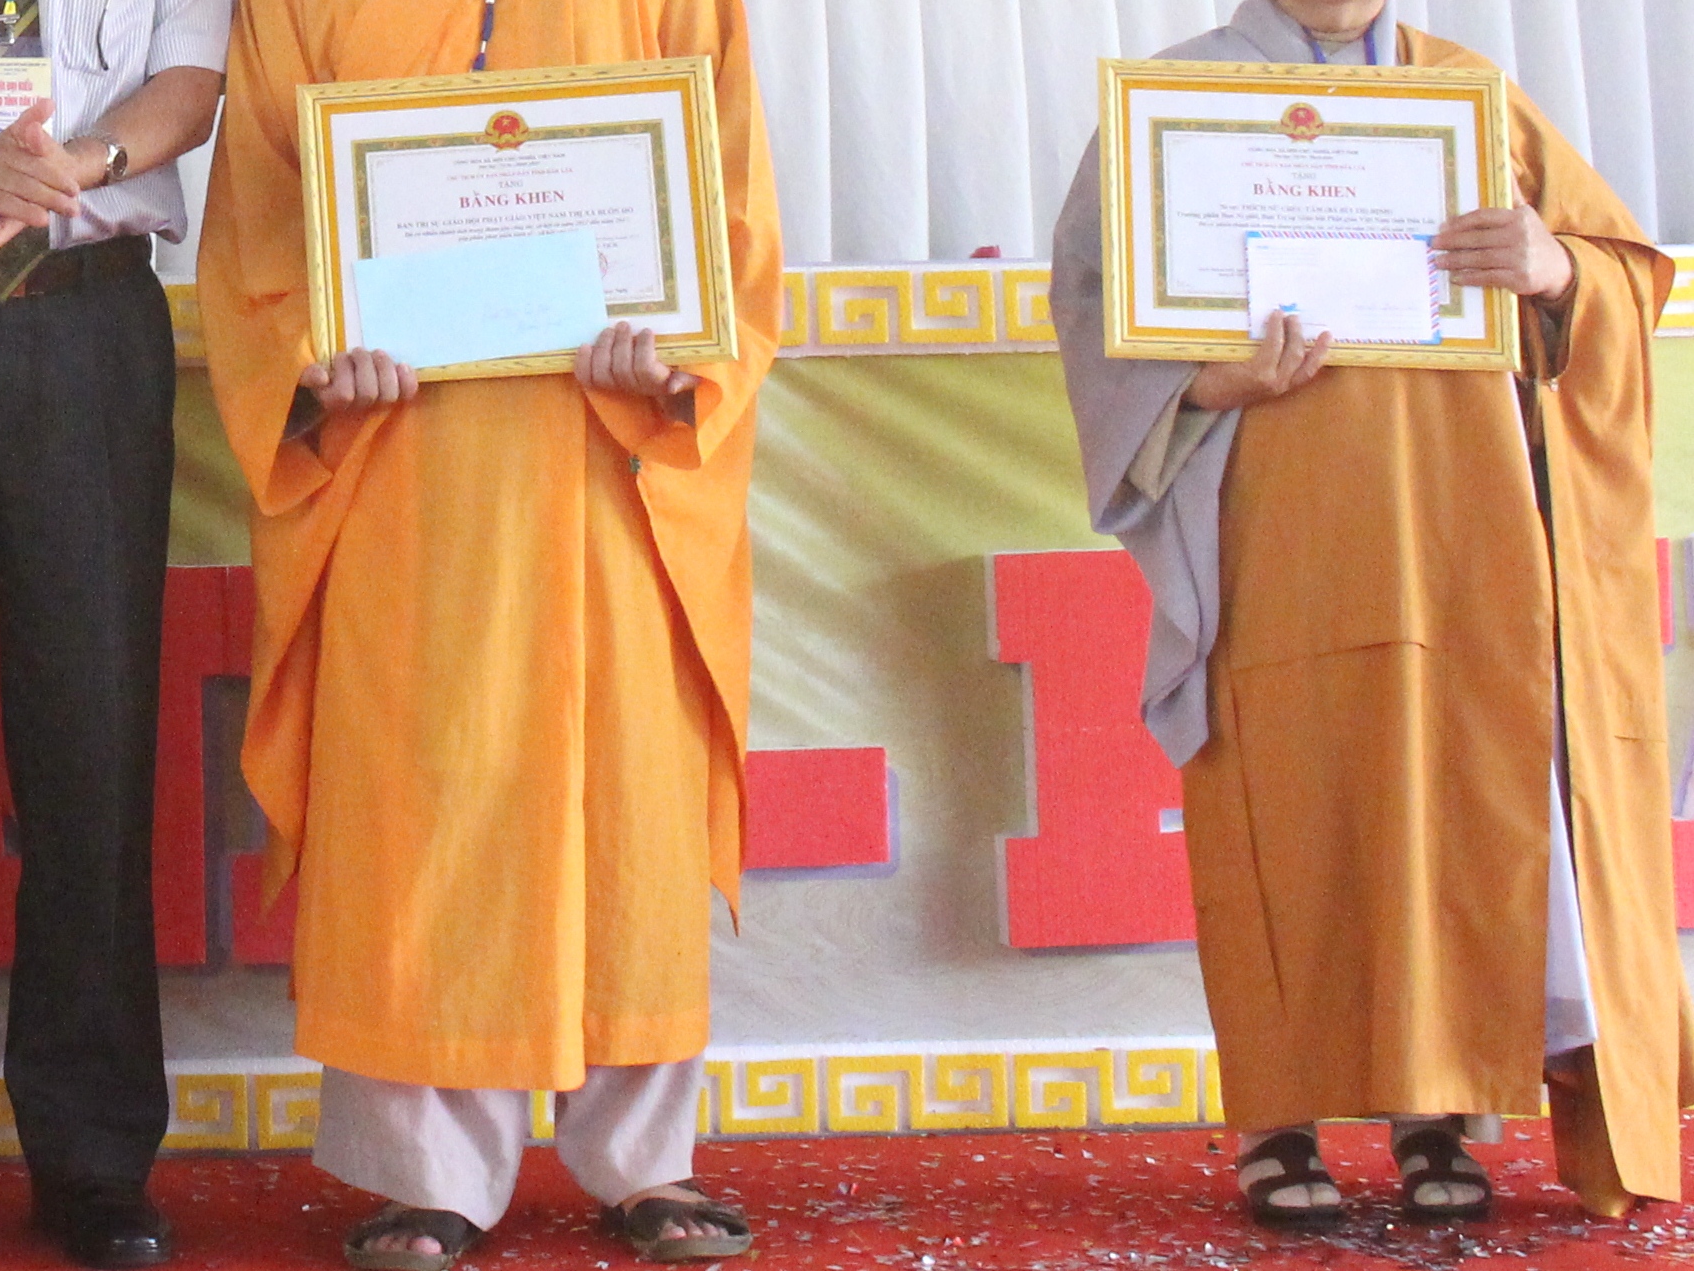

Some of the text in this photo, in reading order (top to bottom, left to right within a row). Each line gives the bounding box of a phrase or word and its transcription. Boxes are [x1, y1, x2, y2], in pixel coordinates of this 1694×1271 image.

[1253, 179, 1357, 199] BẰNG KHEN
[459, 190, 566, 209] BẰNG KHEN
